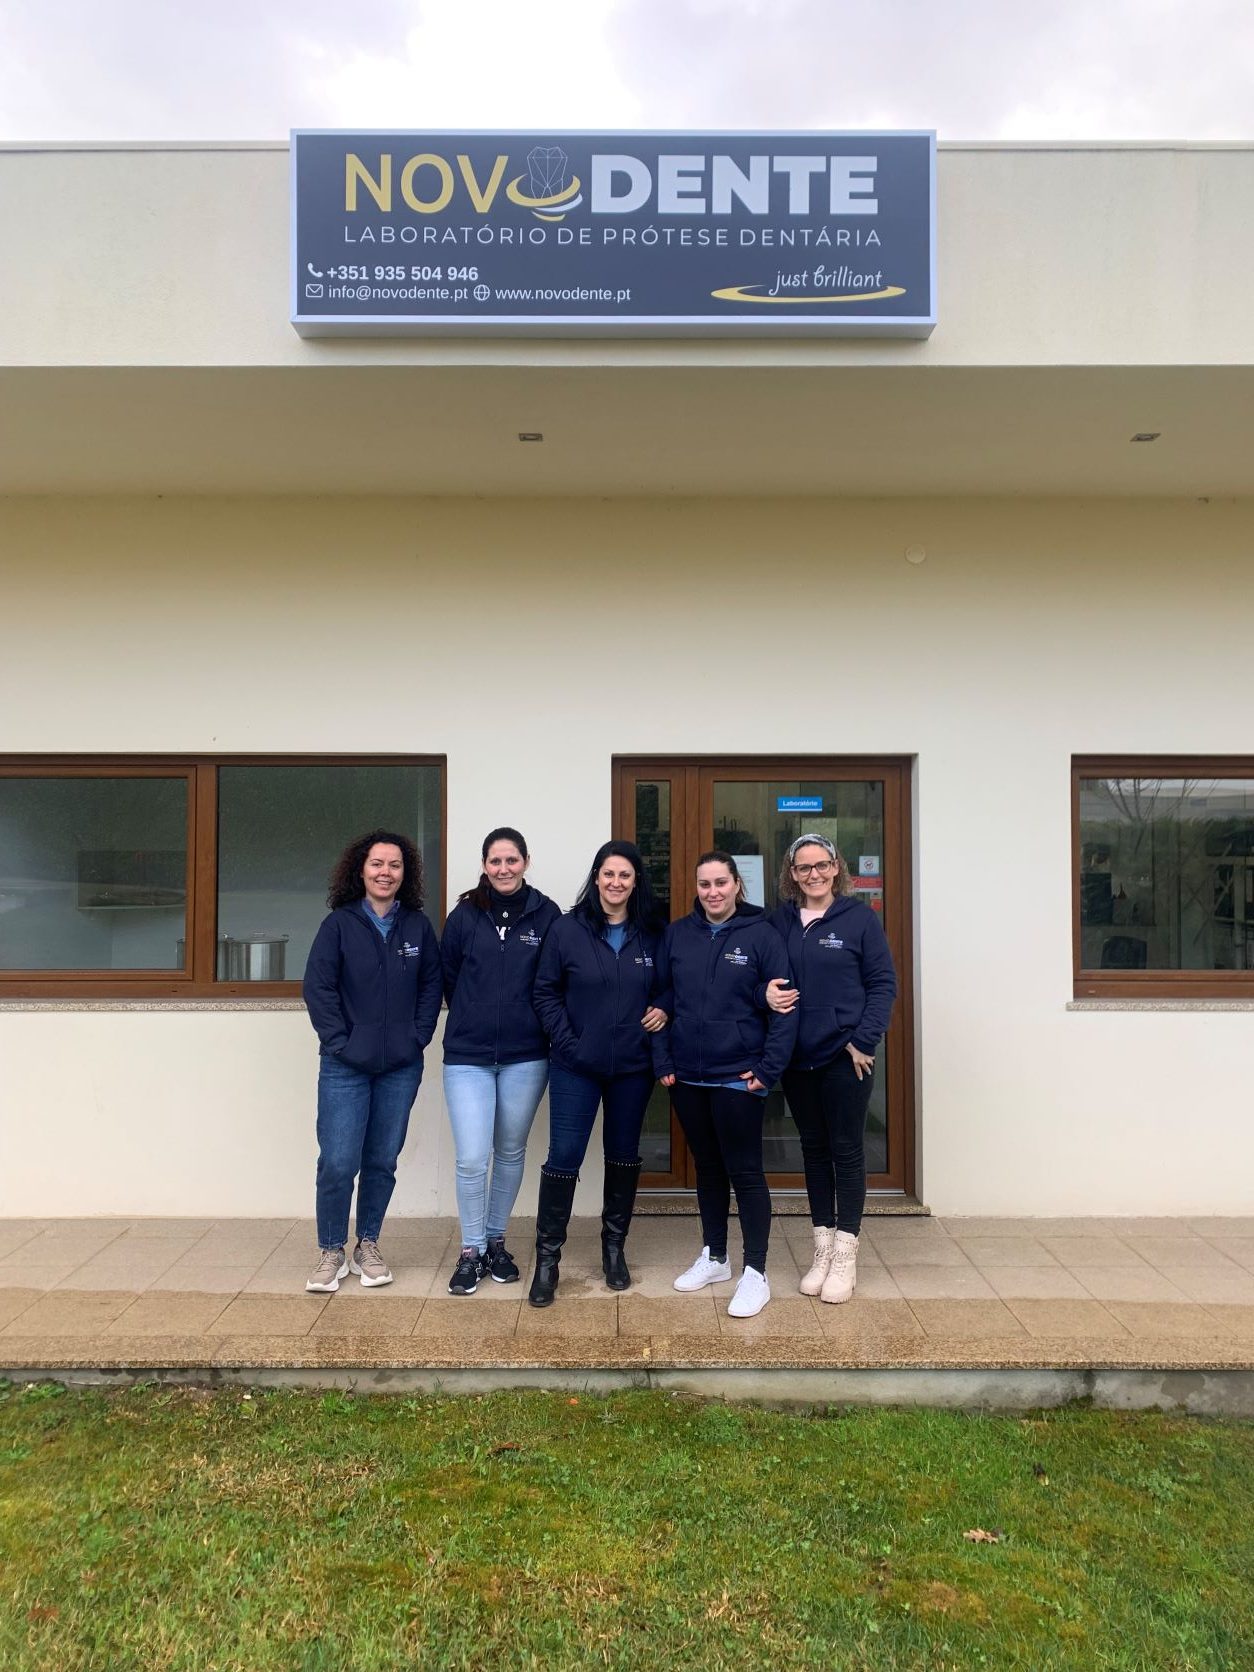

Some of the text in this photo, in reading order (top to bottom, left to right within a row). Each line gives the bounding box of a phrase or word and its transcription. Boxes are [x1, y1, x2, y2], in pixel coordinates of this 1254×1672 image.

[344, 223, 882, 247] LABORATÓRIO DE PRÓTESE DENTÁRIA
[326, 265, 480, 282] +351 935 504 946
[767, 264, 884, 296] just brilliant
[328, 284, 469, 303] info@novodente.pt
[494, 286, 632, 304] www.novodente.pt
